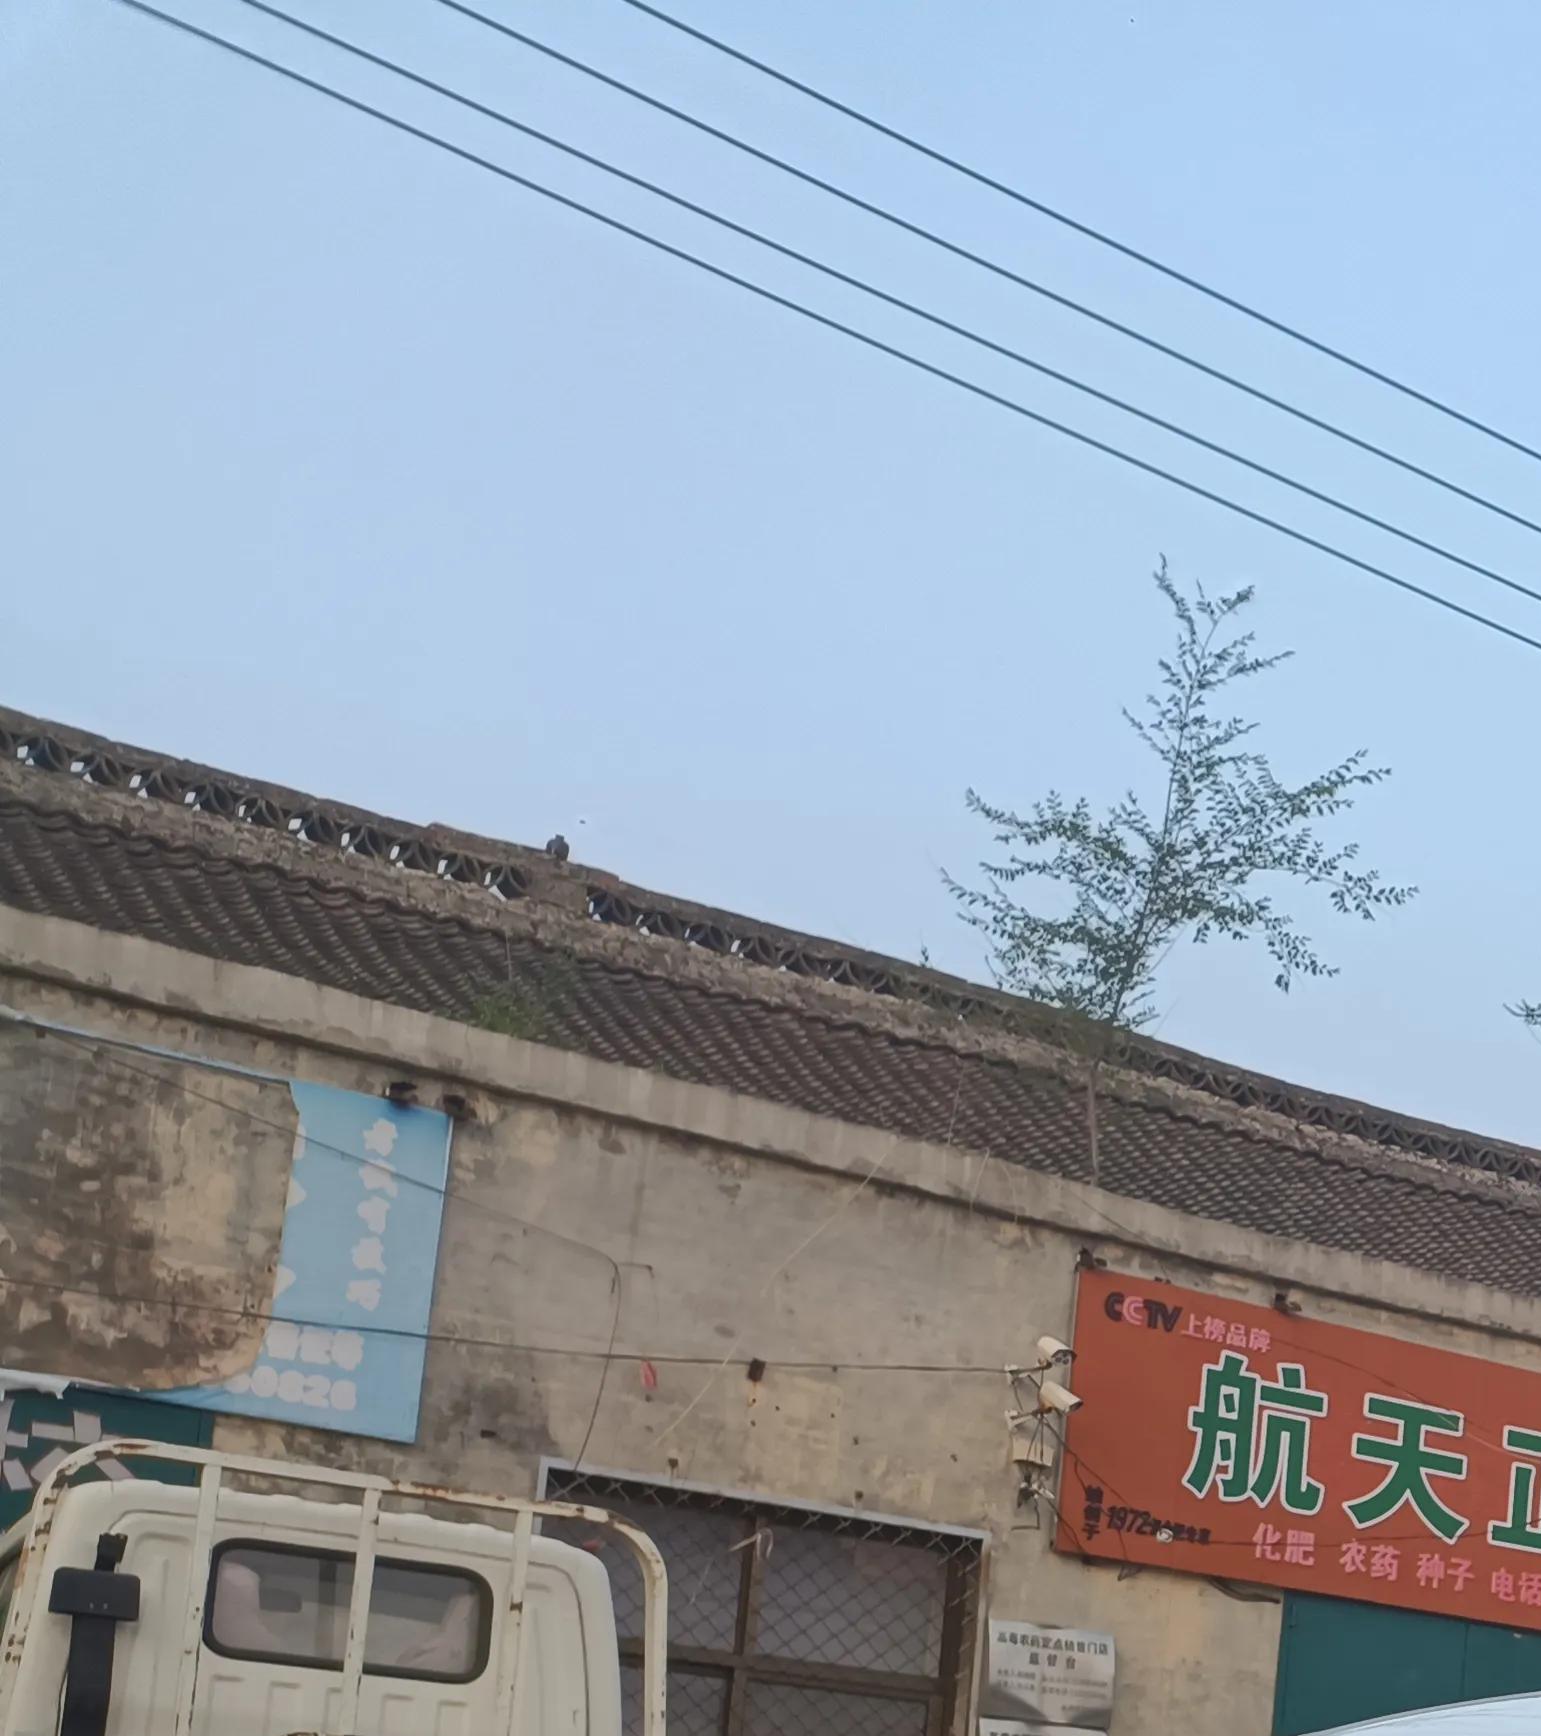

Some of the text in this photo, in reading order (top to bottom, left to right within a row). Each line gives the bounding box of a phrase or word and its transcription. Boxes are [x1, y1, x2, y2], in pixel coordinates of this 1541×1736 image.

[1104, 1291, 1271, 1353] CCTV 上榜品牌
[1252, 1522, 1316, 1566] 化肥
[1340, 1538, 1401, 1581] 农药
[1416, 1552, 1475, 1592] 种子
